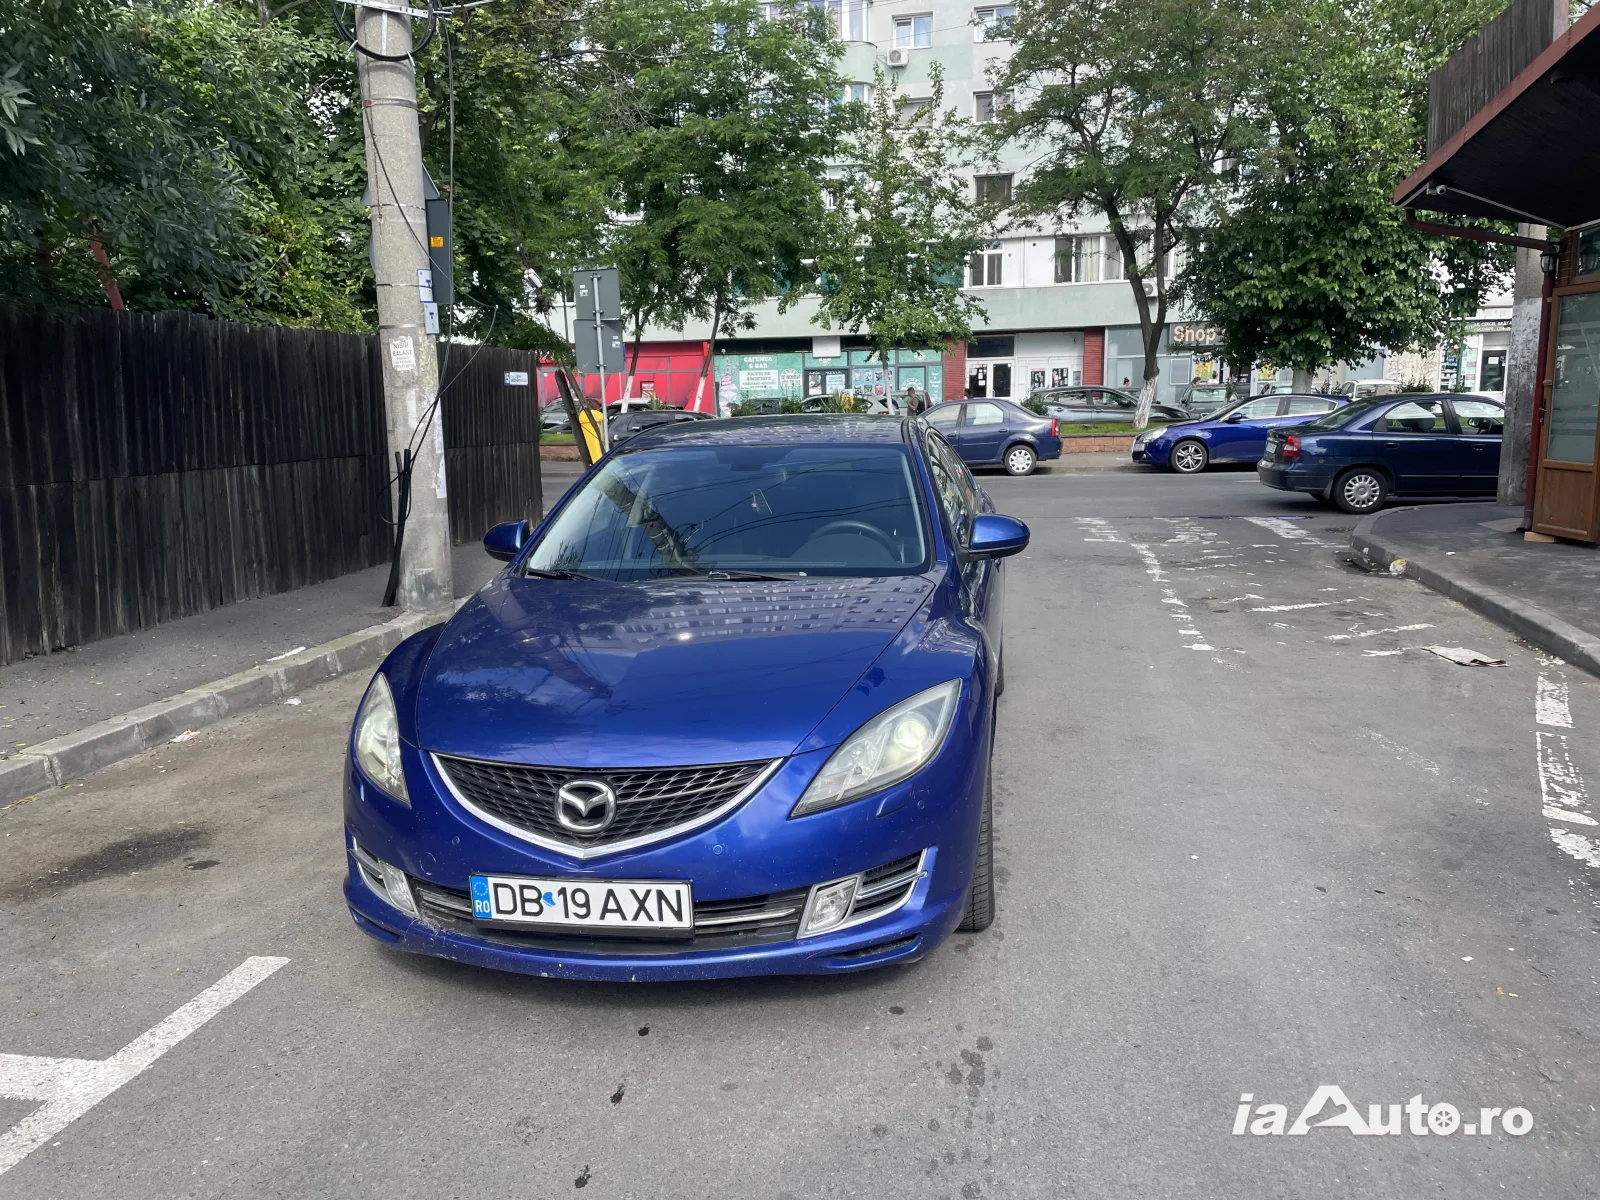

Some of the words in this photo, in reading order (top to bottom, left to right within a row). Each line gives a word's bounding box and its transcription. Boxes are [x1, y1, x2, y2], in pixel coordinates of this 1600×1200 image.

[1173, 325, 1216, 345] Shop
[475, 899, 490, 914] RO
[493, 883, 544, 917] DB
[557, 886, 591, 920] 19
[600, 888, 683, 922] AXN
